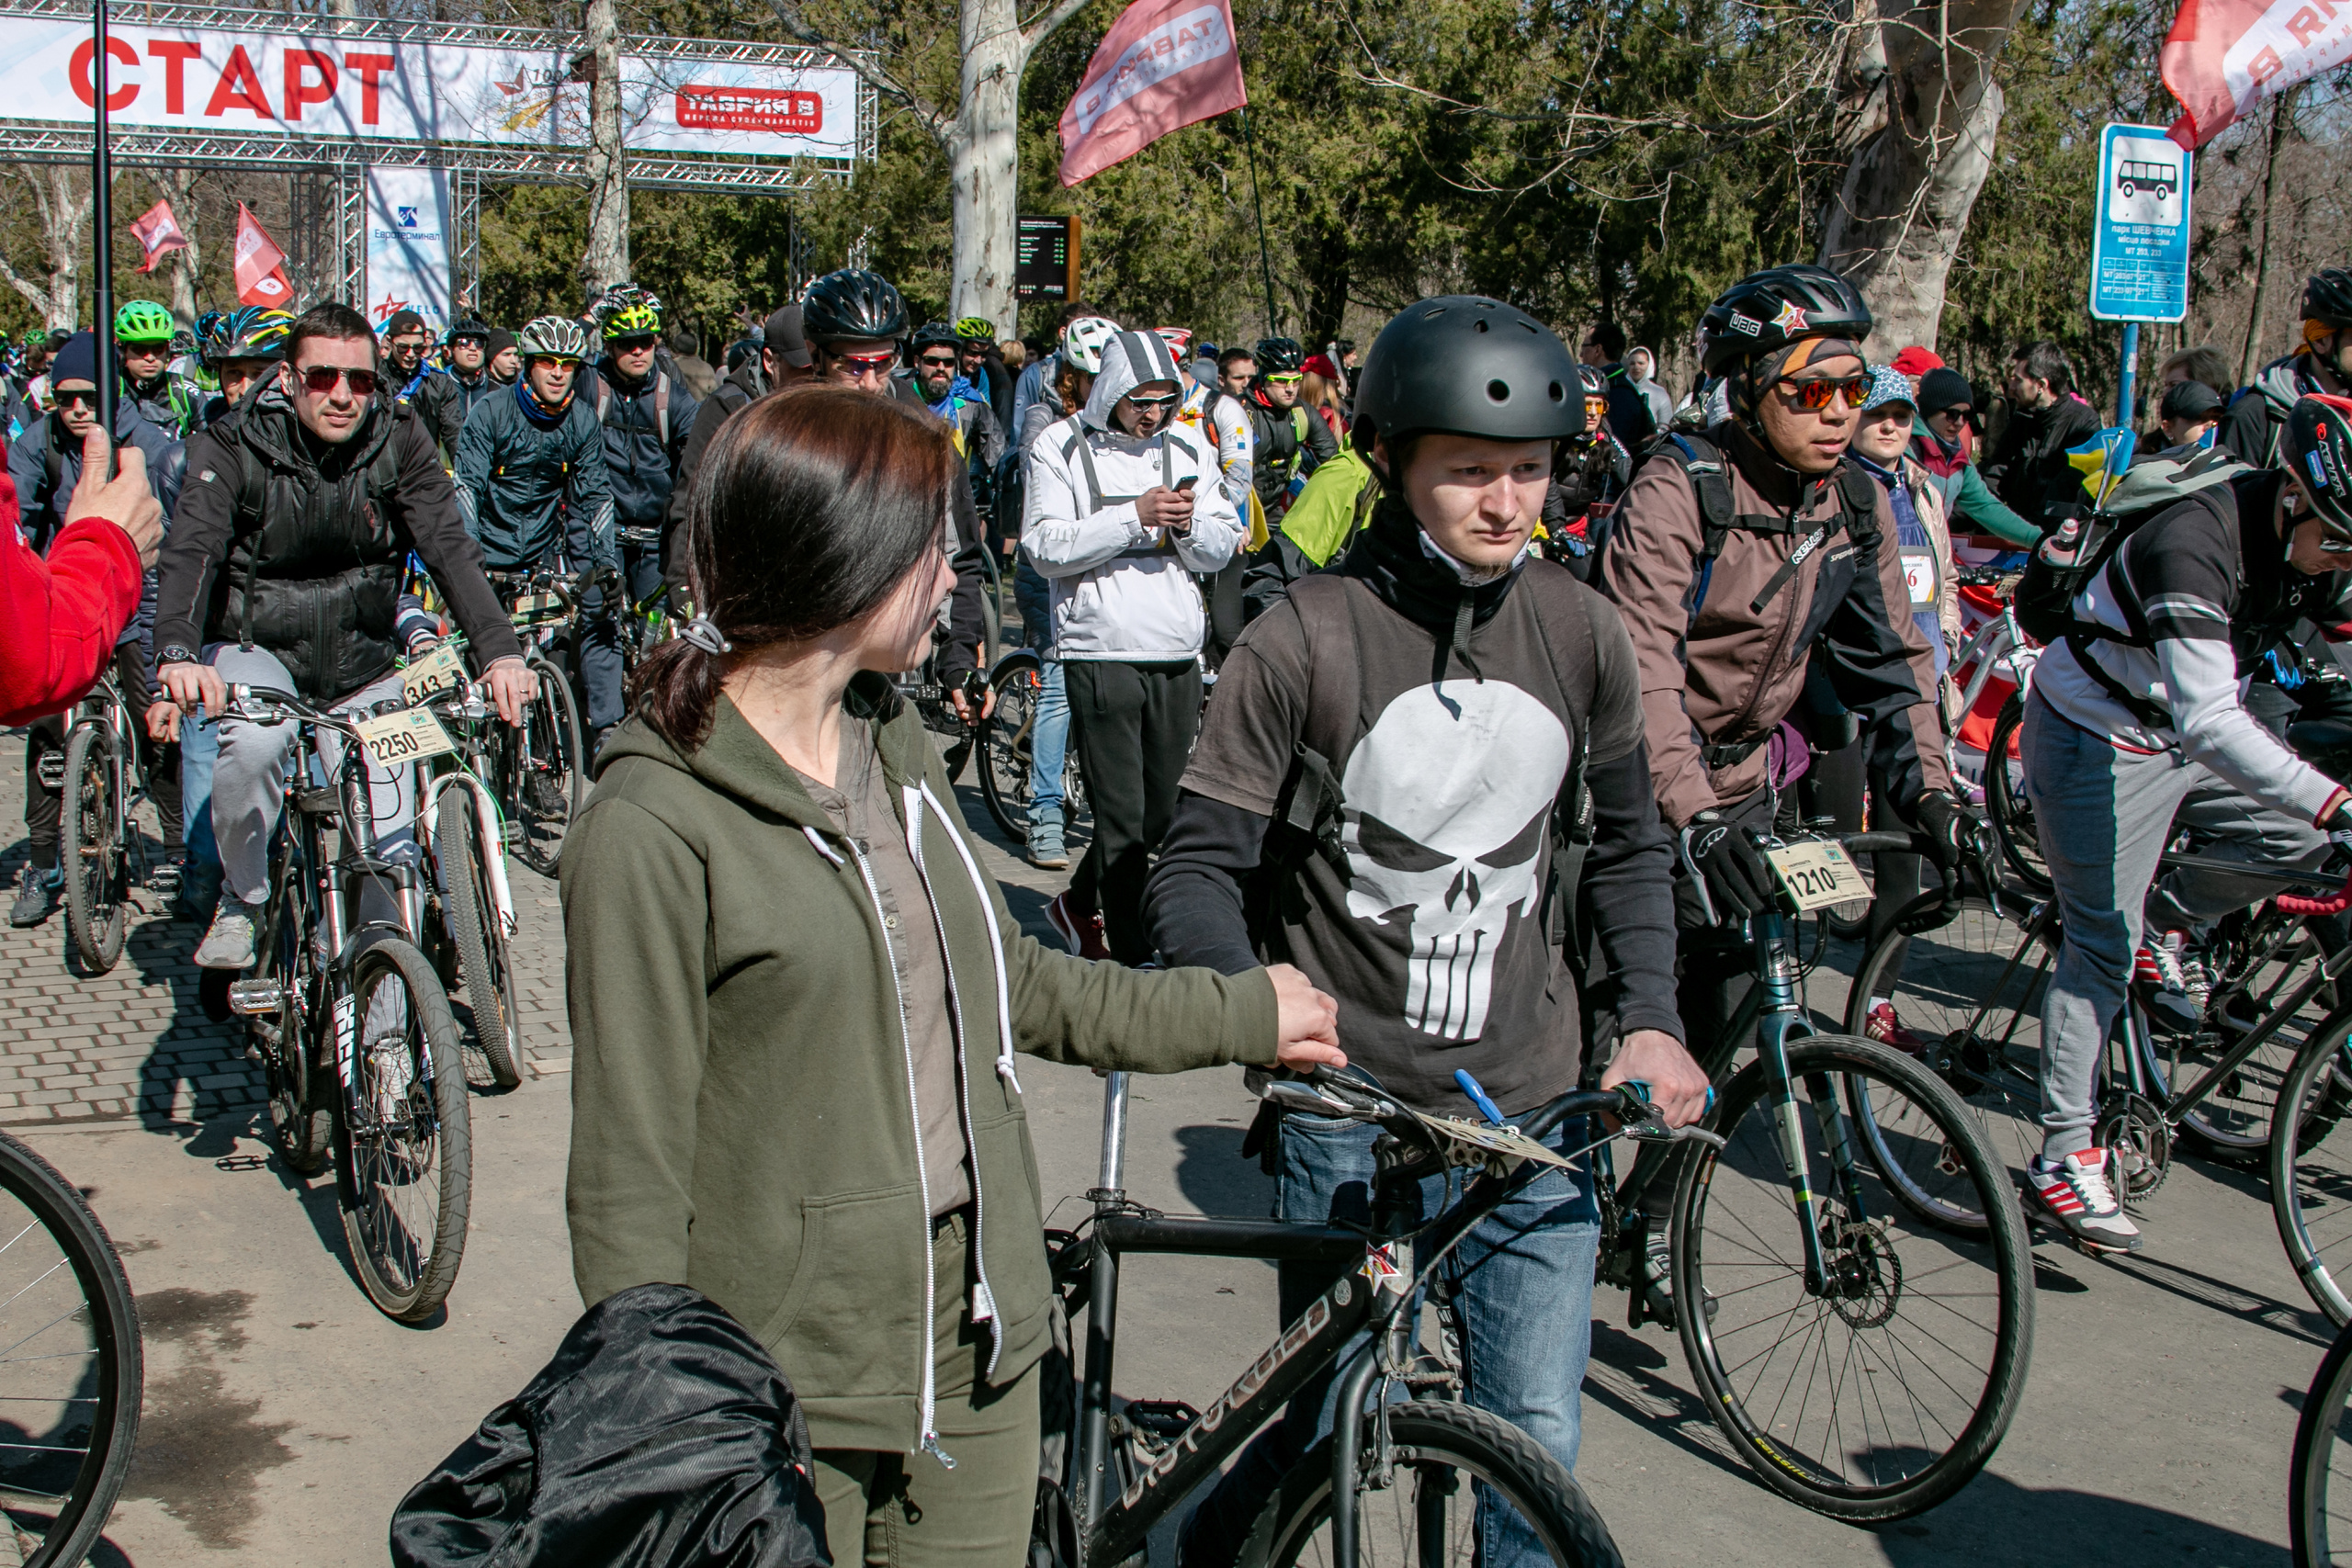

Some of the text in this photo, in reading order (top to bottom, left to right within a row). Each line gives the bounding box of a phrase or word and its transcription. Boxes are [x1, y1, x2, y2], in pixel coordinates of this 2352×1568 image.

[69, 35, 395, 126] СТАРТ
[684, 94, 815, 117] ТАВРИЯ В
[374, 228, 441, 242] Евротерминал
[2111, 225, 2177, 237] парк ШЕВЧЕНКА
[405, 304, 441, 315] VELO
[406, 674, 443, 706] 343
[368, 730, 420, 761] 2250
[1786, 866, 1838, 897] 1210
